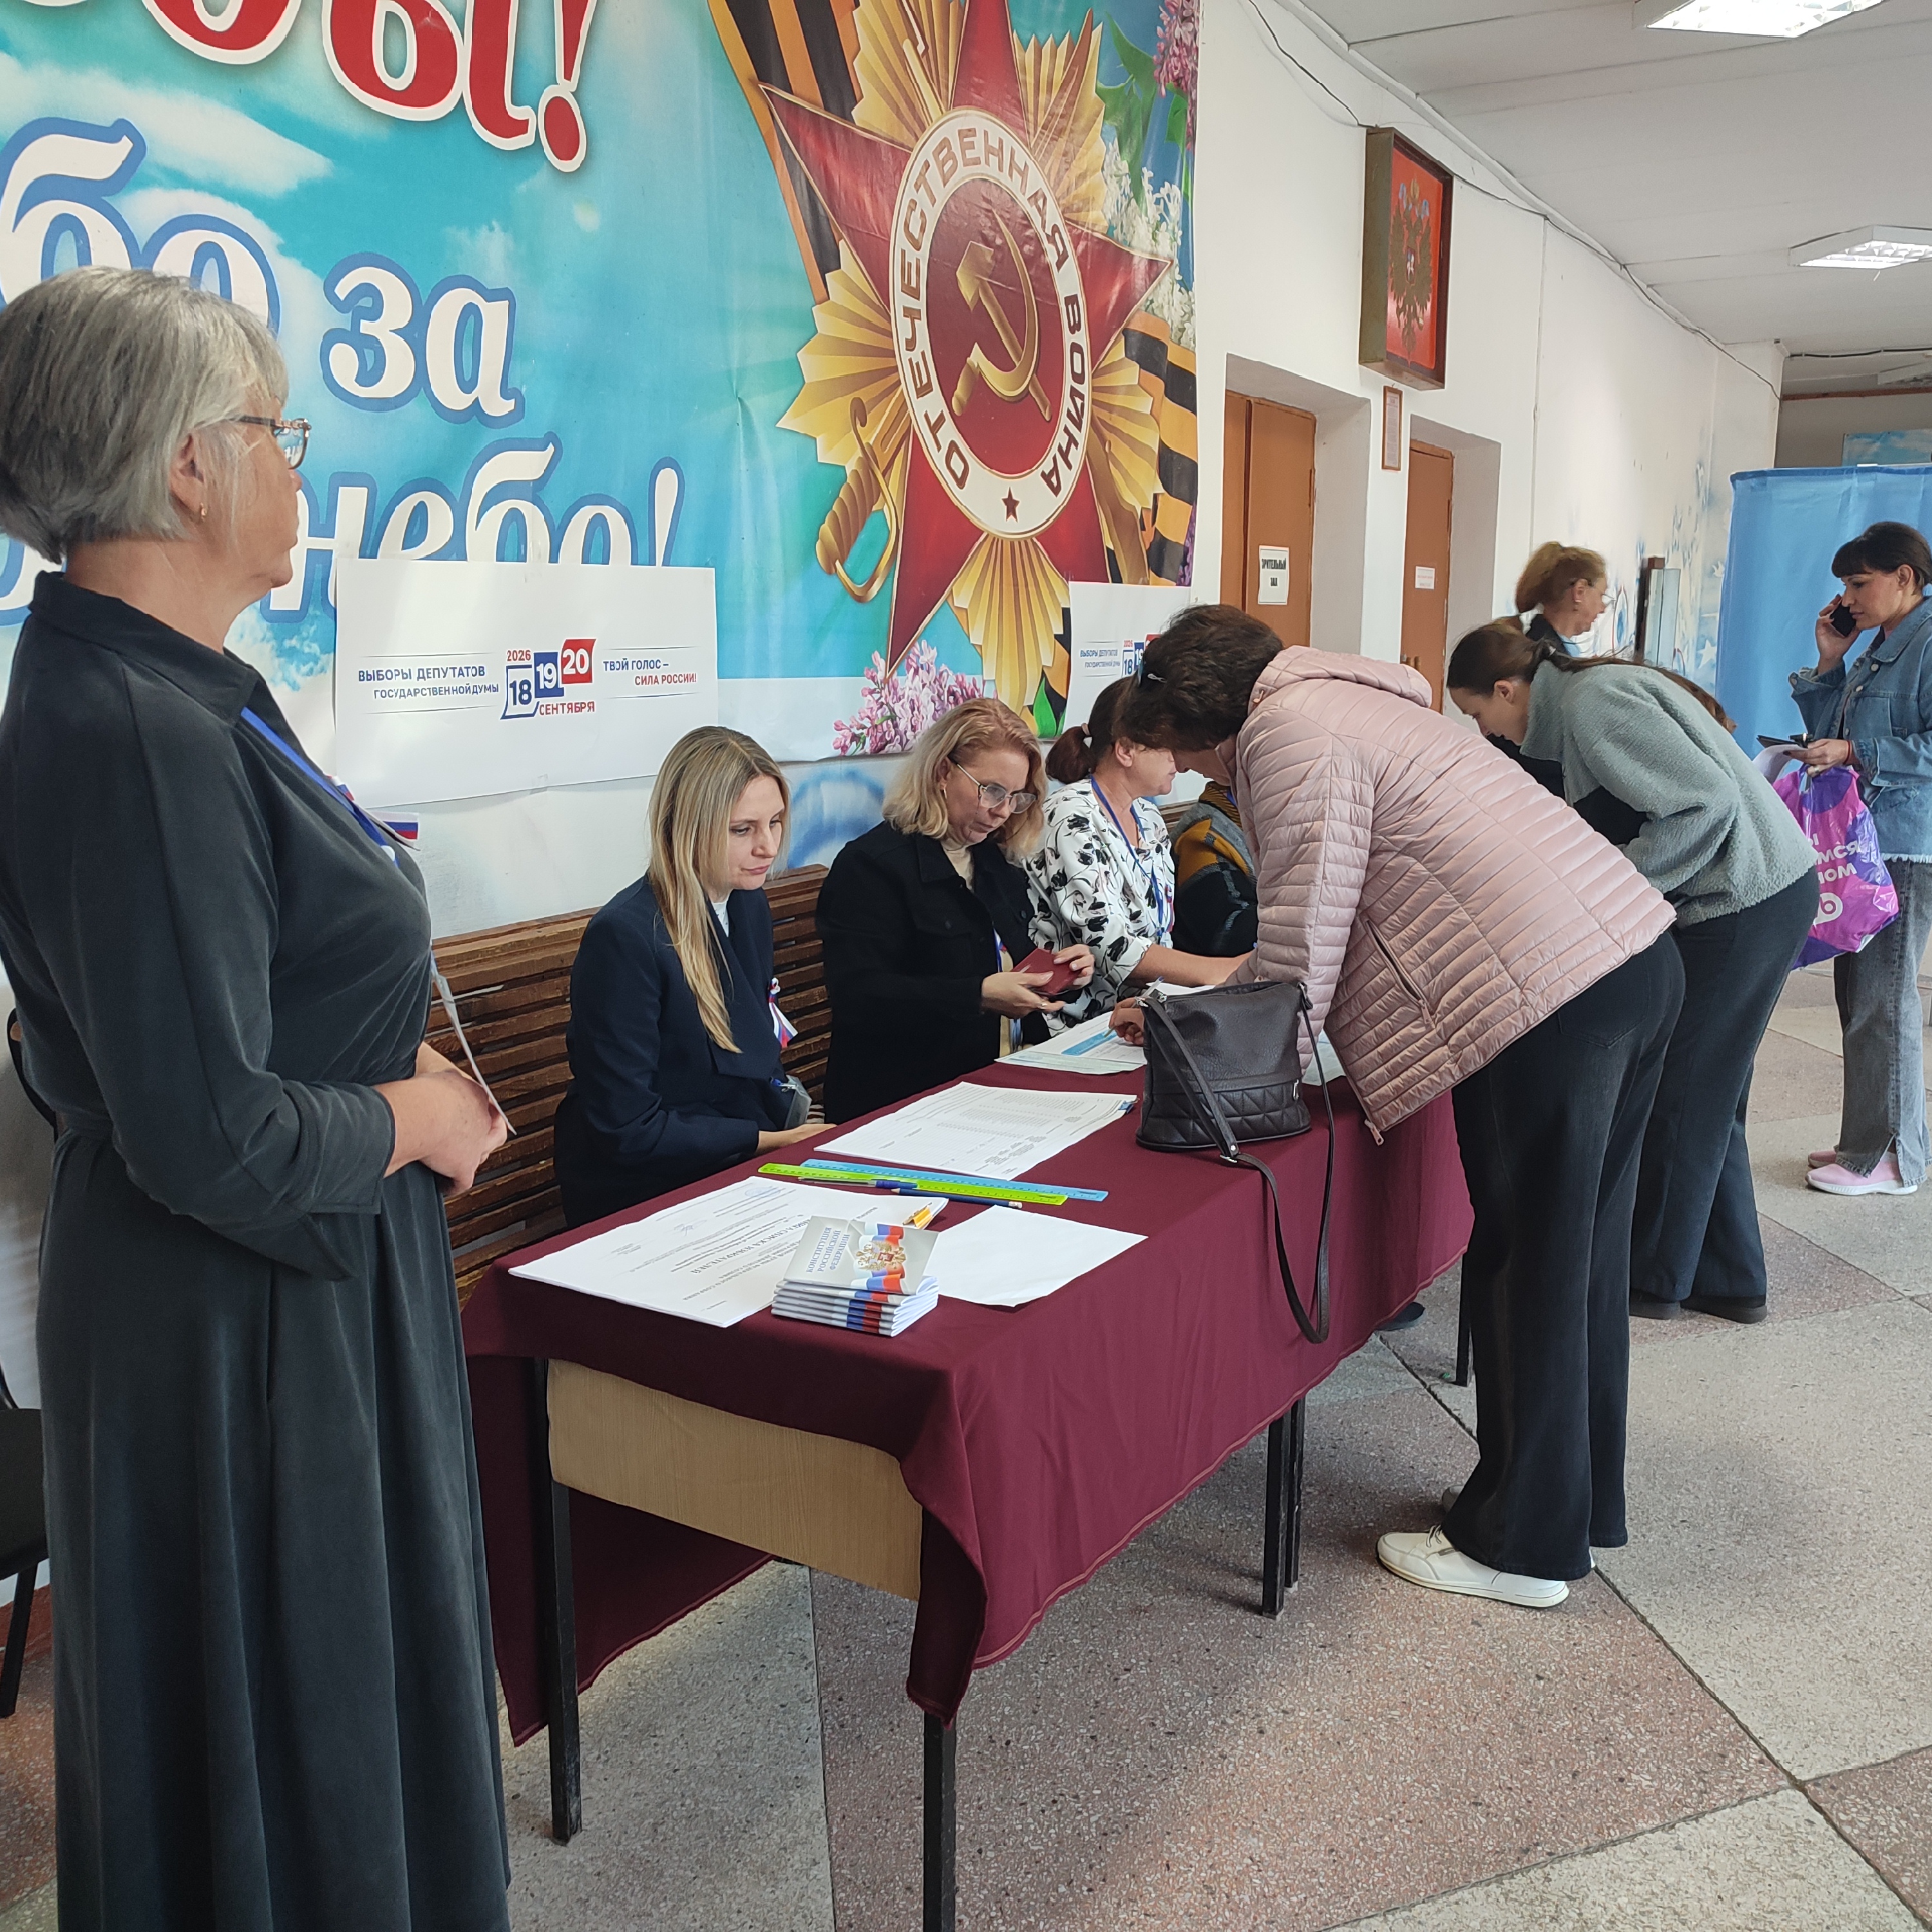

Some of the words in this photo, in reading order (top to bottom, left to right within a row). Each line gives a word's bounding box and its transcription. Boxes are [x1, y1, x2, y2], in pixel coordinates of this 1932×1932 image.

[901, 128, 1070, 489] ОТЕЧЕСТВЕННАЯ
[1041, 294, 1086, 497] ВОЙНА
[328, 267, 516, 417] за
[507, 649, 531, 661] 2026
[1080, 649, 1098, 658] ВЫБОРЫ
[358, 668, 412, 682] ВЫБОРЫ
[416, 665, 486, 681] ДЕПУТАТОВ
[603, 658, 629, 671] ТВОЙ
[631, 659, 661, 670] ГОЛОС
[1124, 658, 1133, 675] 18
[509, 679, 532, 706] 18
[536, 663, 557, 689] 19
[562, 649, 589, 675] 20
[634, 674, 659, 686] СИЛА
[661, 673, 697, 684] РОССИИ!
[374, 683, 471, 699] ГОСУДАРСТВЕННОЙ
[471, 683, 499, 696] ДУМЫ
[539, 701, 595, 715] СЕНТЯБРЯ
[1815, 840, 1860, 866] МСЯ
[752, 1229, 788, 1247] СПИСКА
[690, 1245, 755, 1273] ИЗБИРАТЕЛЕЙ
[806, 1227, 832, 1273] КОНСТИТУЦИЯ
[817, 1230, 841, 1273] РОССИЙСКОЙ
[829, 1234, 850, 1271] ФЕДЕРАЦИИ
